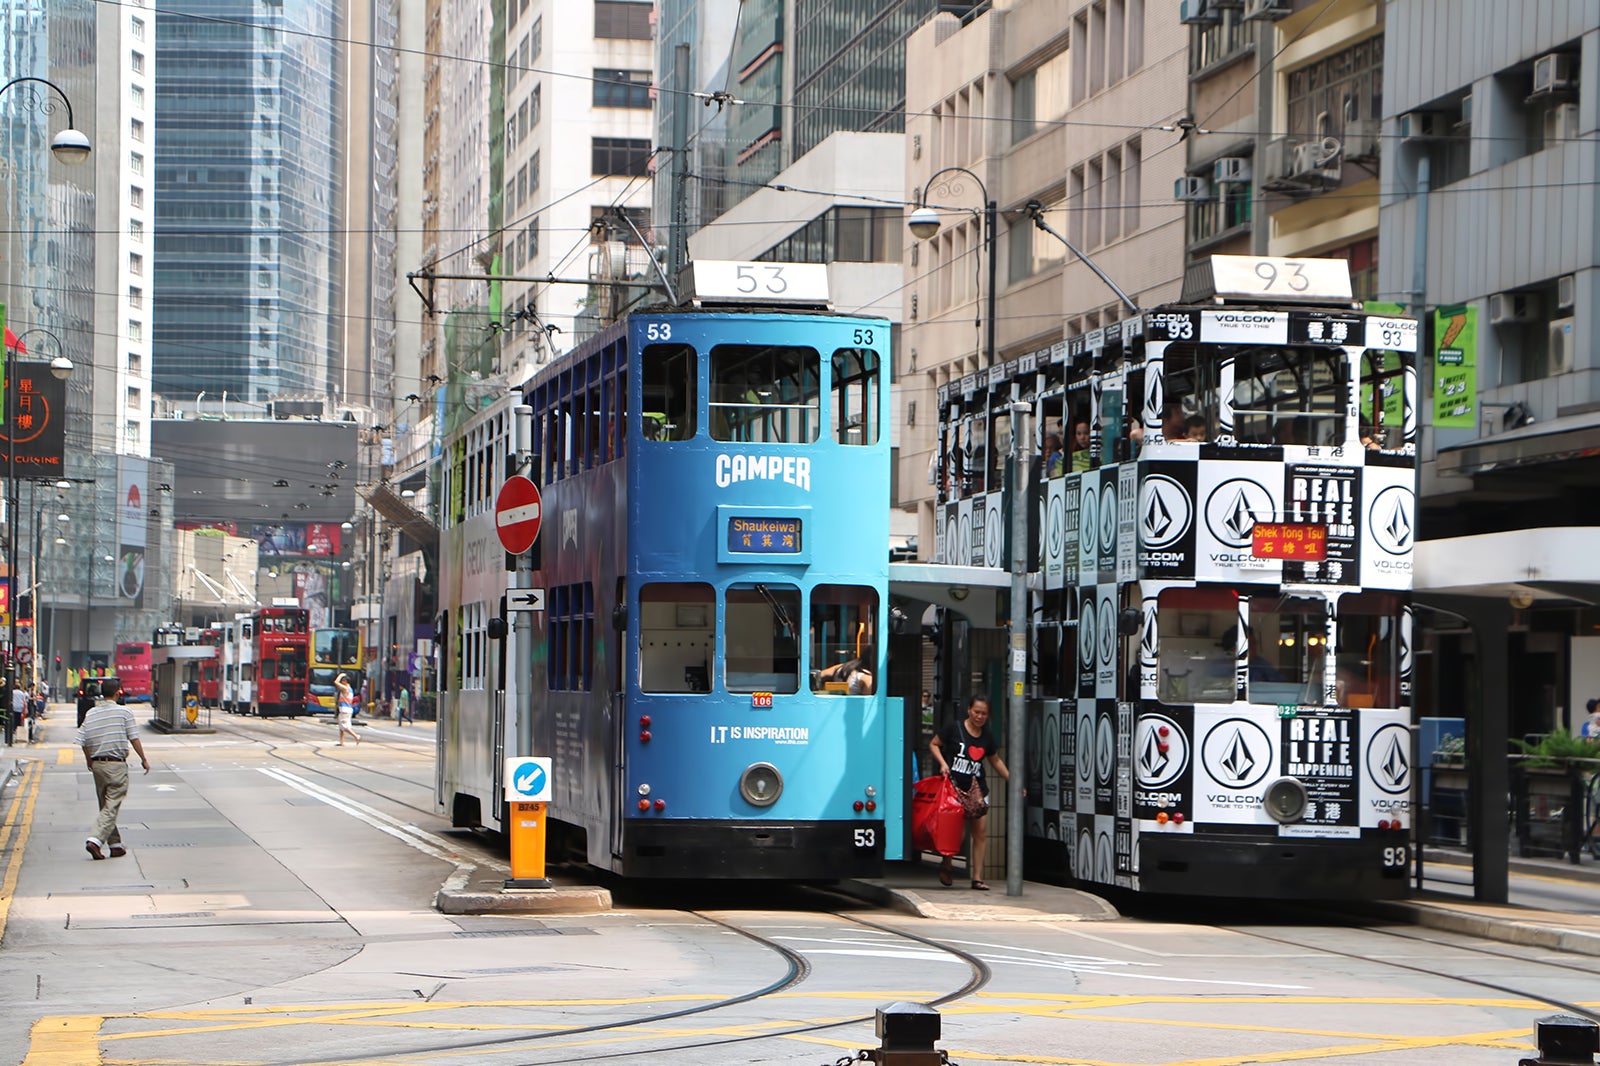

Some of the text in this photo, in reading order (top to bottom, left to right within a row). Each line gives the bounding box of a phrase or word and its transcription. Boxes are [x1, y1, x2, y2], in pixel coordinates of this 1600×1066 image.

[736, 265, 787, 294] 53
[1255, 262, 1309, 291] 93
[1215, 315, 1275, 323] VOLCOM
[1379, 321, 1417, 330] VOLCO
[647, 323, 671, 340] 53
[853, 329, 874, 345] 53
[1168, 321, 1193, 340] 93
[1382, 330, 1402, 346] 93
[15, 455, 59, 465] CUISINE
[716, 454, 811, 492] CAMPER
[1293, 478, 1353, 503] REAL
[1293, 501, 1352, 525] LIFE
[734, 520, 795, 533] Shaukeiwa
[1254, 526, 1278, 538] Shek
[1281, 526, 1303, 541] Tong
[1306, 527, 1326, 539] Tsui
[1138, 552, 1185, 562] OLCOM
[754, 697, 771, 706] 106
[1279, 706, 1297, 715] 025
[711, 726, 809, 744] I.T IS INSPIRATION
[1290, 718, 1350, 742] REAL
[1290, 741, 1350, 765] LIFE
[1288, 763, 1353, 777] HAPPENING
[1135, 792, 1182, 802] OLCOM
[518, 803, 540, 812] B745
[854, 829, 875, 847] 53
[1384, 847, 1406, 866] 93
